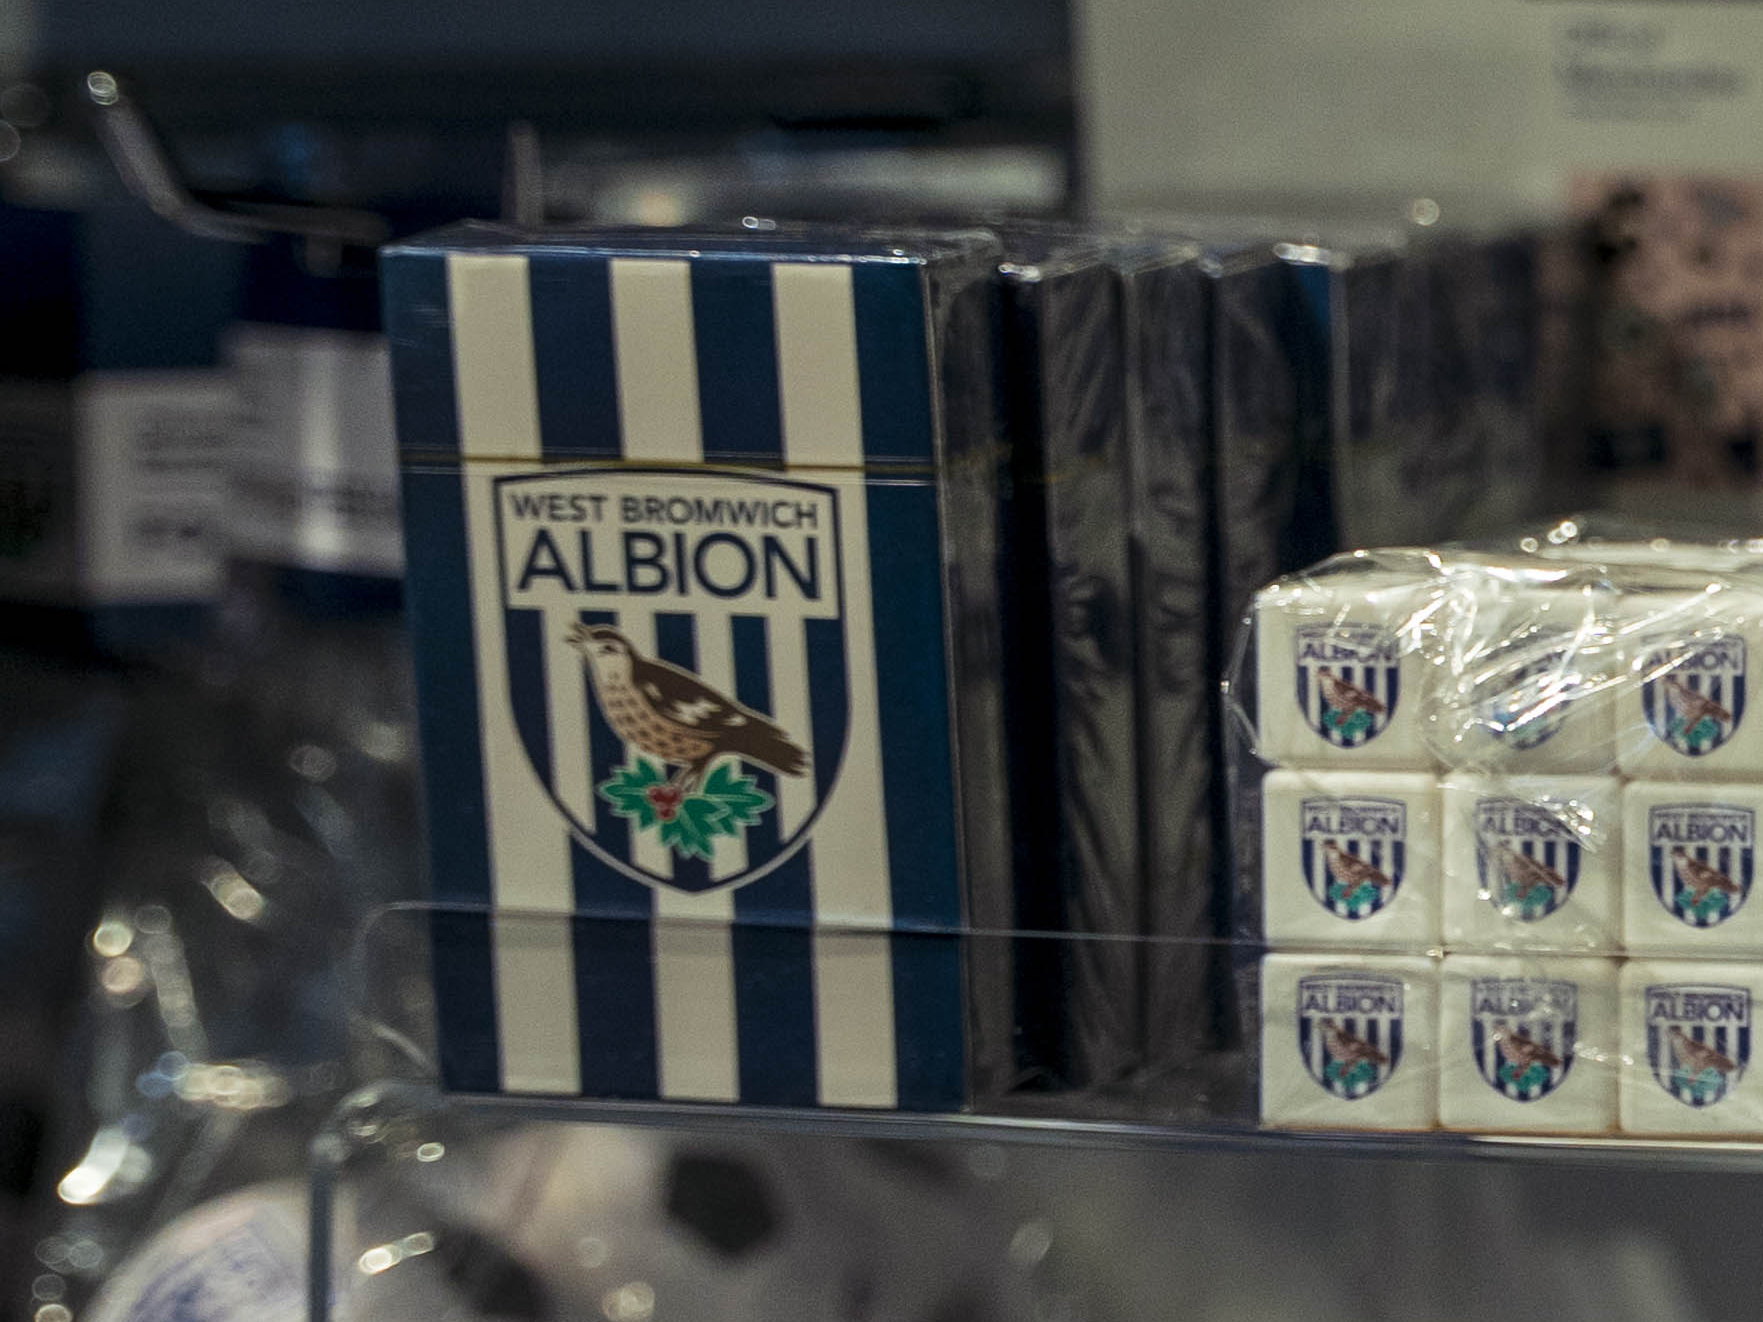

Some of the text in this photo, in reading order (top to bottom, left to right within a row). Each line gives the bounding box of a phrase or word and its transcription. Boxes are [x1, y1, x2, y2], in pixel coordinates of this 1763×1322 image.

[510, 493, 818, 529] WEST BROMWICH
[516, 528, 821, 601] ALBION
[1308, 816, 1398, 836] ALBION
[1482, 816, 1559, 837] ALBIO
[1656, 822, 1748, 842] ALBION
[1652, 1000, 1744, 1021] ALBION
